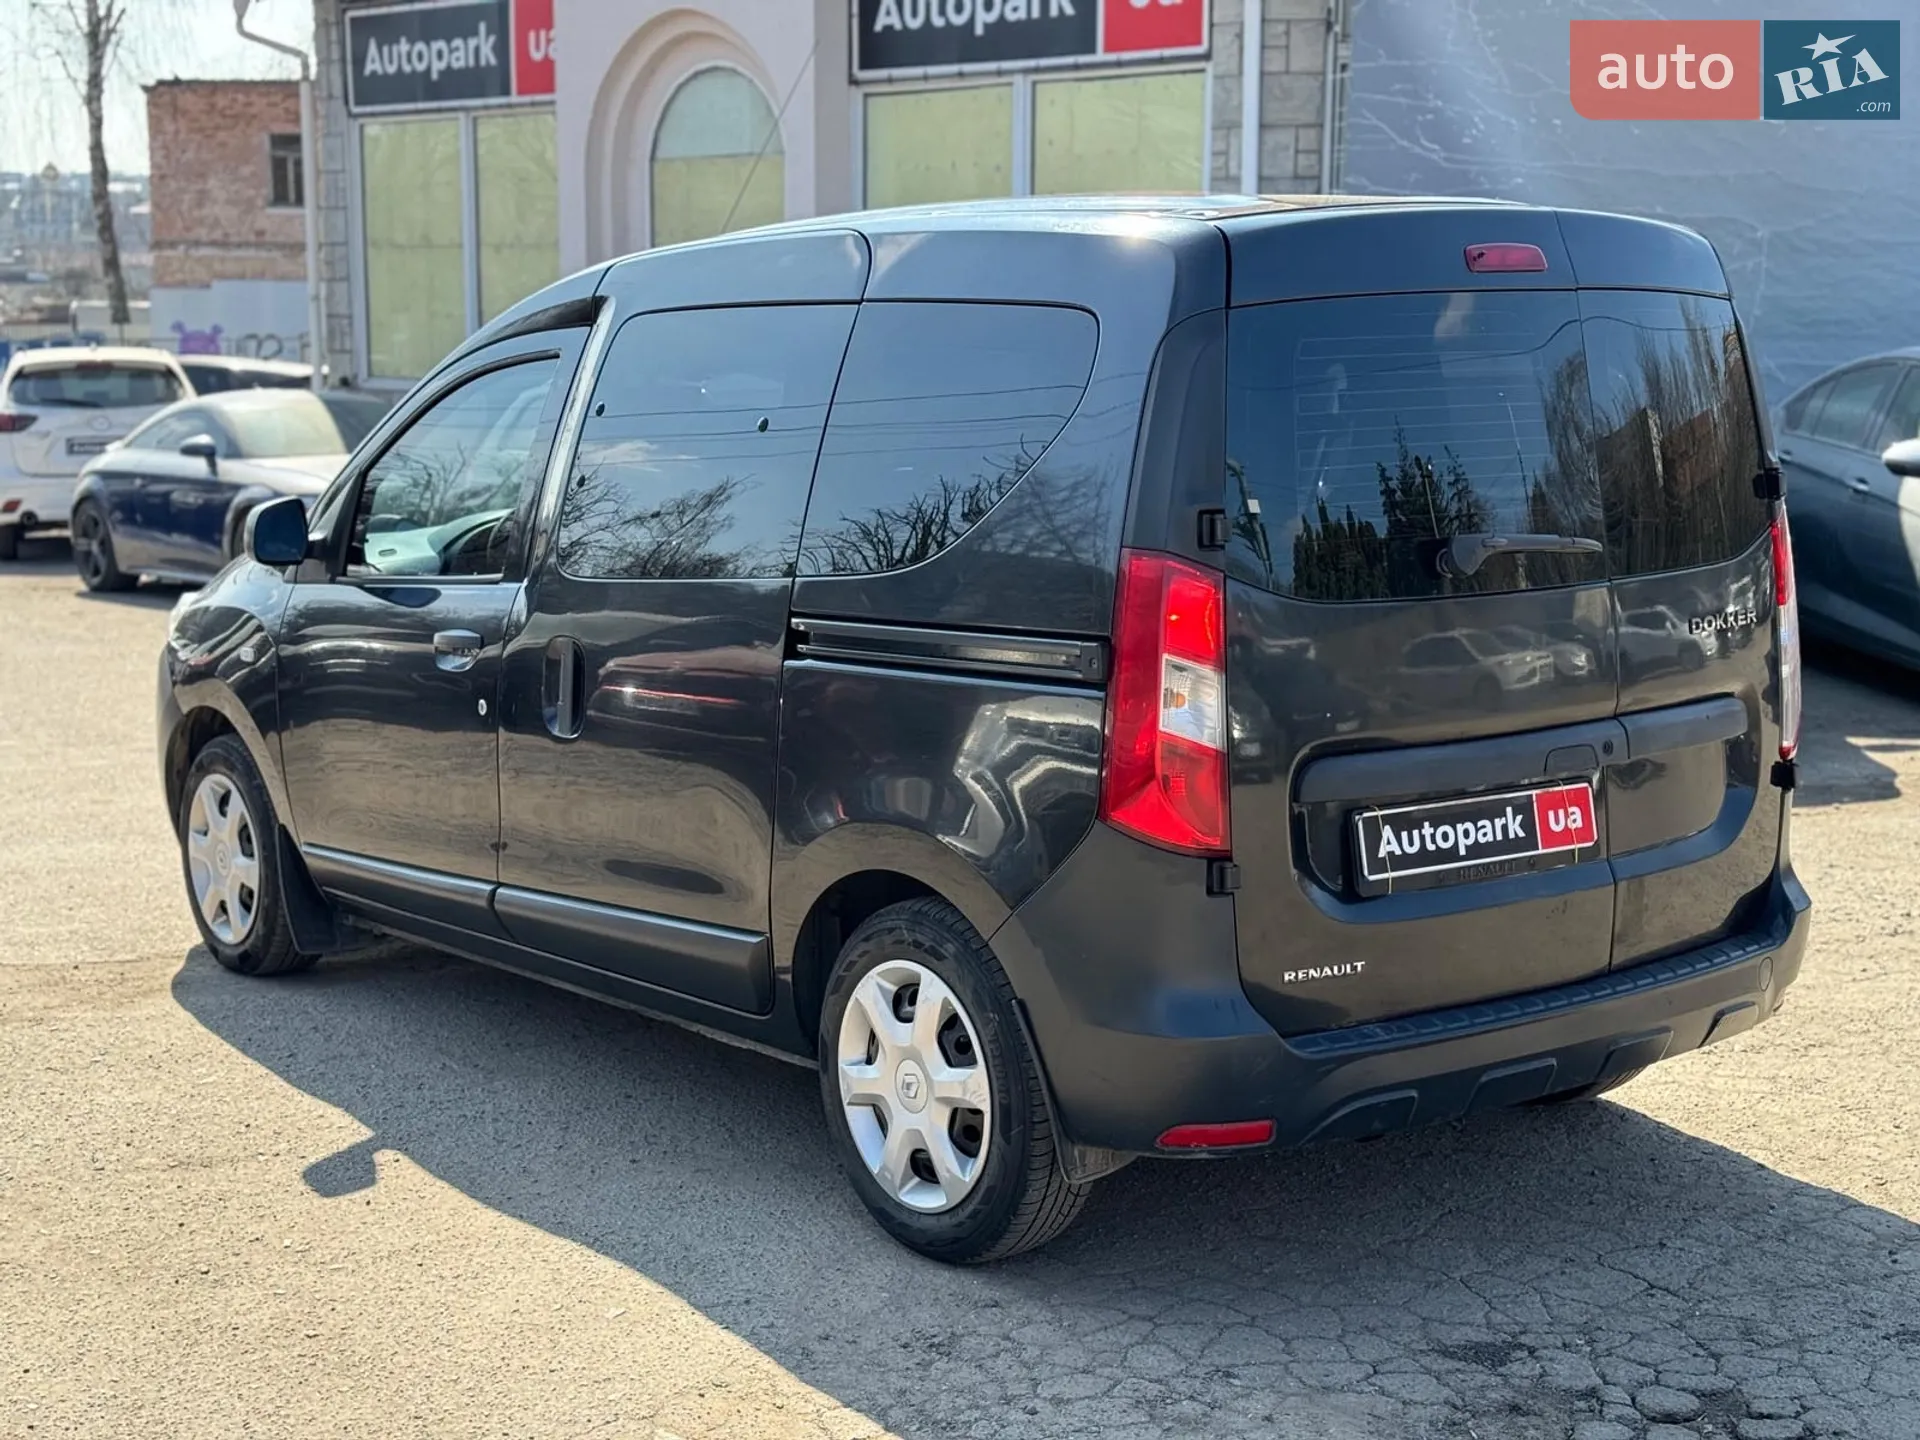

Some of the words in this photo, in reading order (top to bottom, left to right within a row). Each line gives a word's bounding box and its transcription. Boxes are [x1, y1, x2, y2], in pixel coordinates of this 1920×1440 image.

[363, 21, 497, 81] Autopark
[1689, 607, 1757, 634] DOKKER
[1377, 806, 1526, 857] Autopark
[1547, 805, 1584, 832] ua
[1283, 961, 1366, 984] RENAULT
